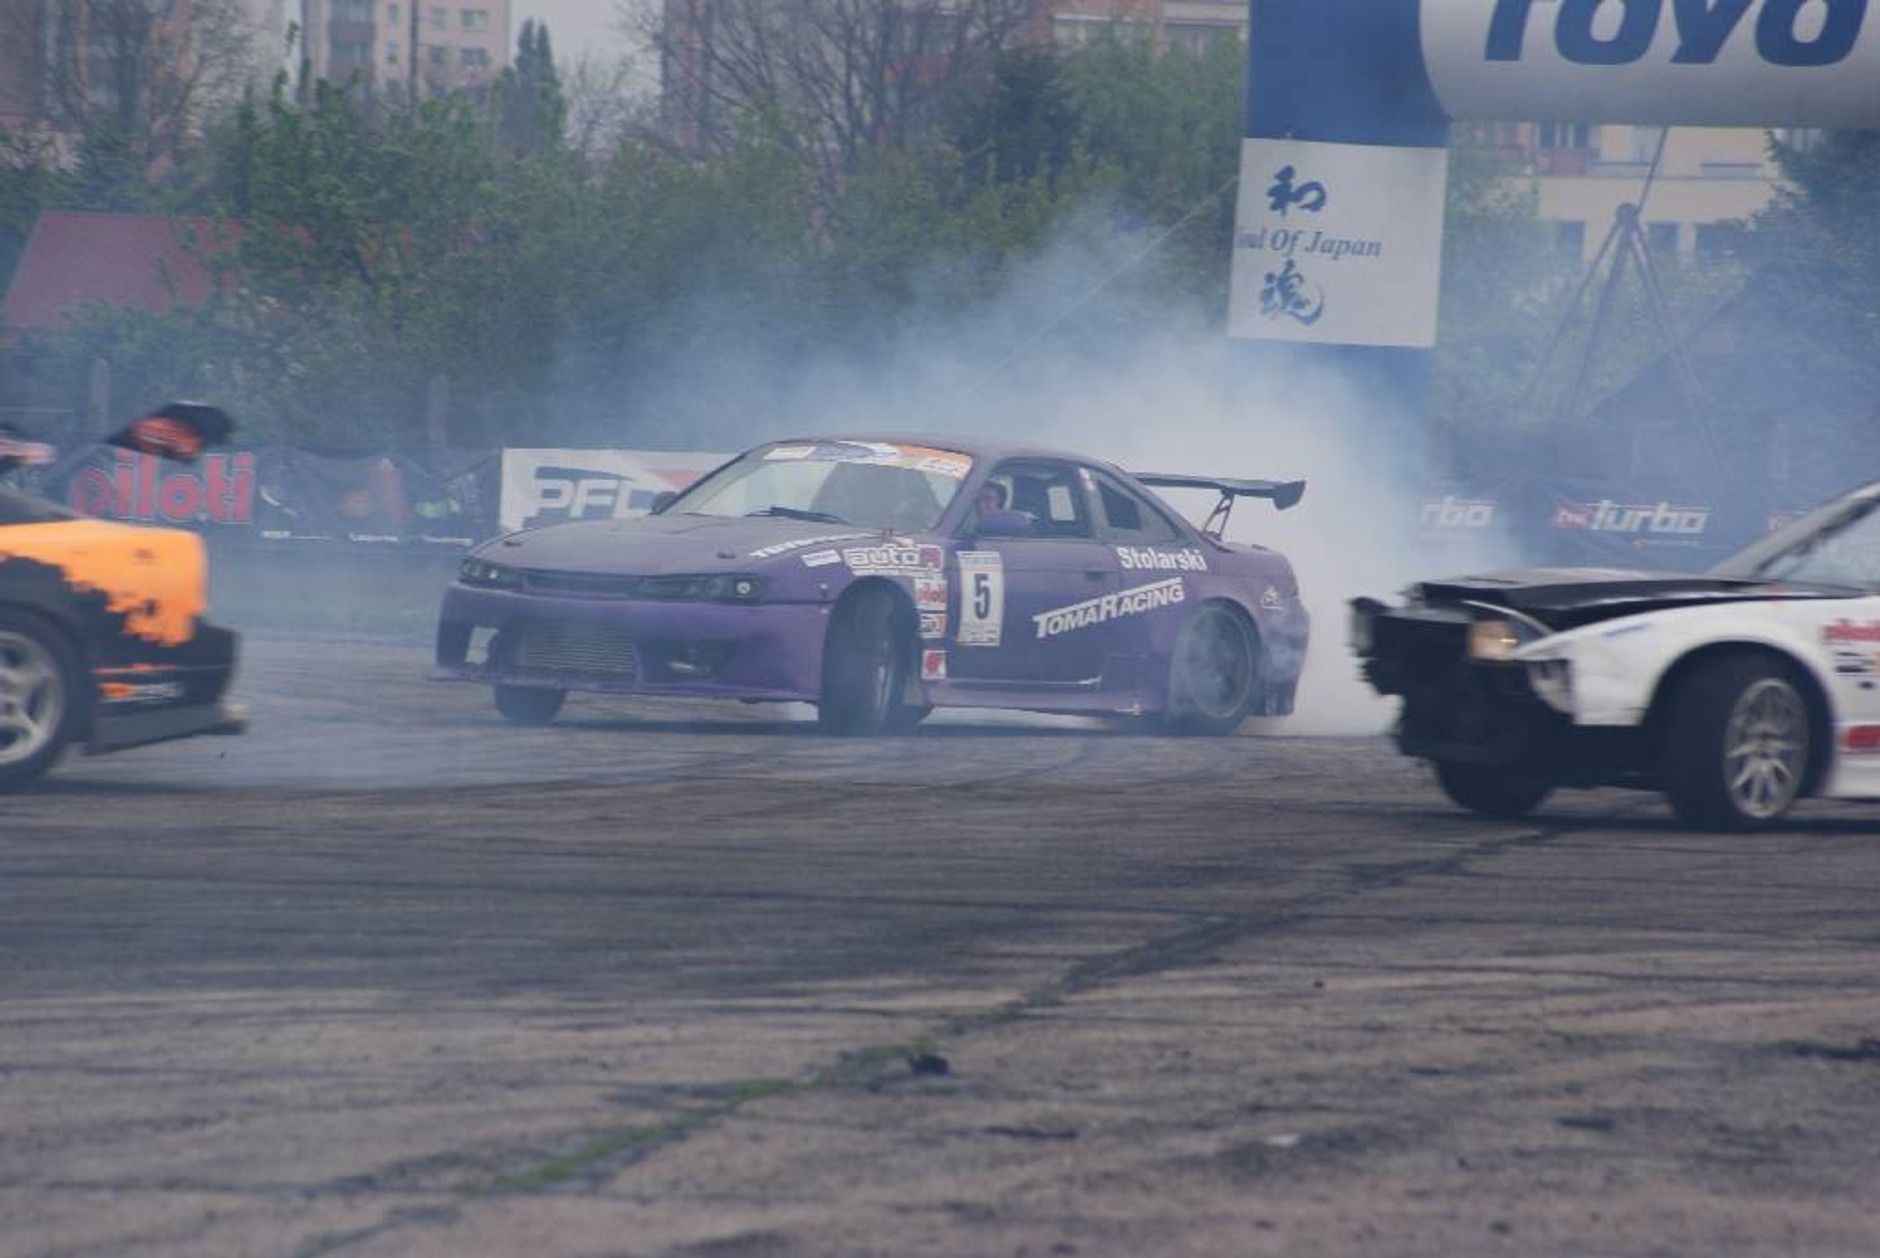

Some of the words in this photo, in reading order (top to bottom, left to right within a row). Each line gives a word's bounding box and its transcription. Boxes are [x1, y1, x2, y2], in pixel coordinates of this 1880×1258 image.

[1270, 228, 1303, 257] Of
[1304, 230, 1382, 261] Japan
[1421, 497, 1494, 529] rbo
[1116, 545, 1208, 571] Stolarski
[973, 572, 991, 620] 5
